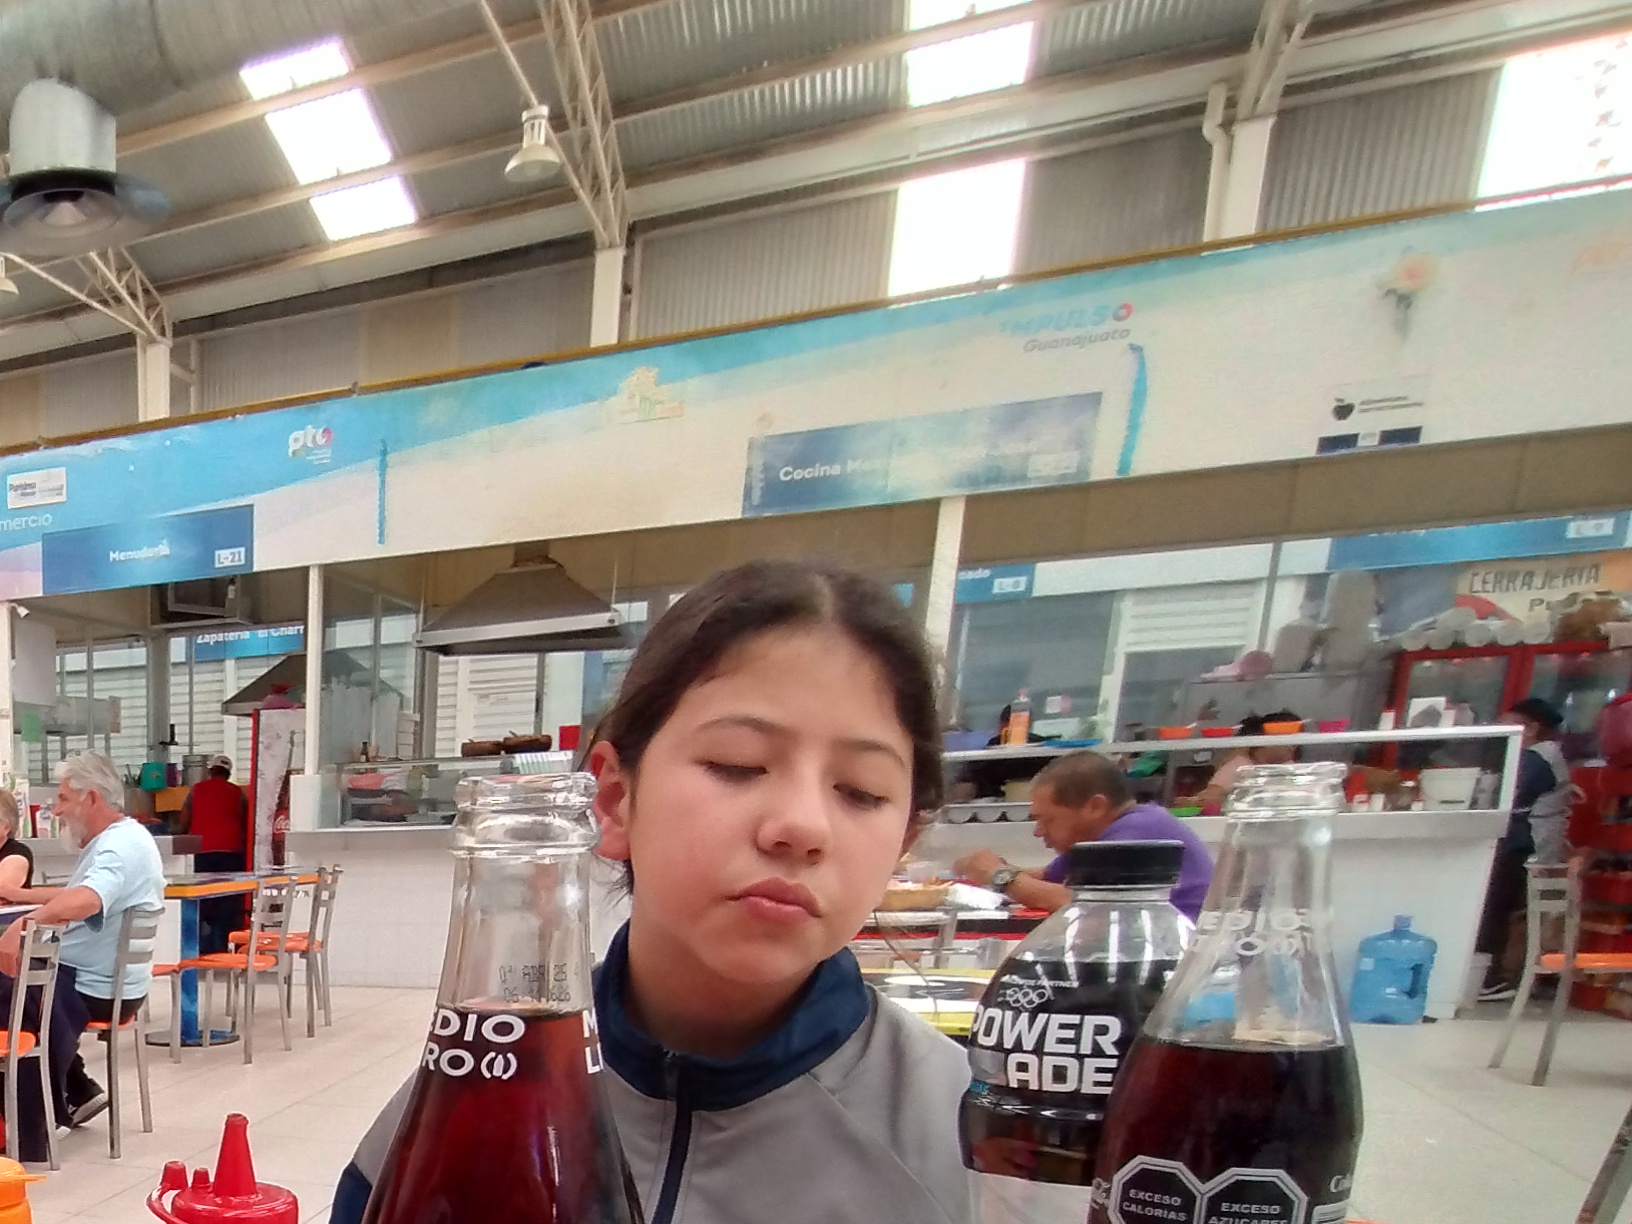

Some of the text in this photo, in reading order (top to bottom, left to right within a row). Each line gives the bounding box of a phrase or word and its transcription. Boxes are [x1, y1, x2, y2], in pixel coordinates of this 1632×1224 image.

[1023, 327, 1131, 353] Guanajuato
[779, 462, 841, 482] Cocina
[217, 549, 243, 563] L-21
[429, 1007, 526, 1043] DIO
[1007, 1053, 1119, 1095] ADE
[1129, 1188, 1182, 1206] EXCESO
[1221, 1202, 1281, 1215] EXCESO
